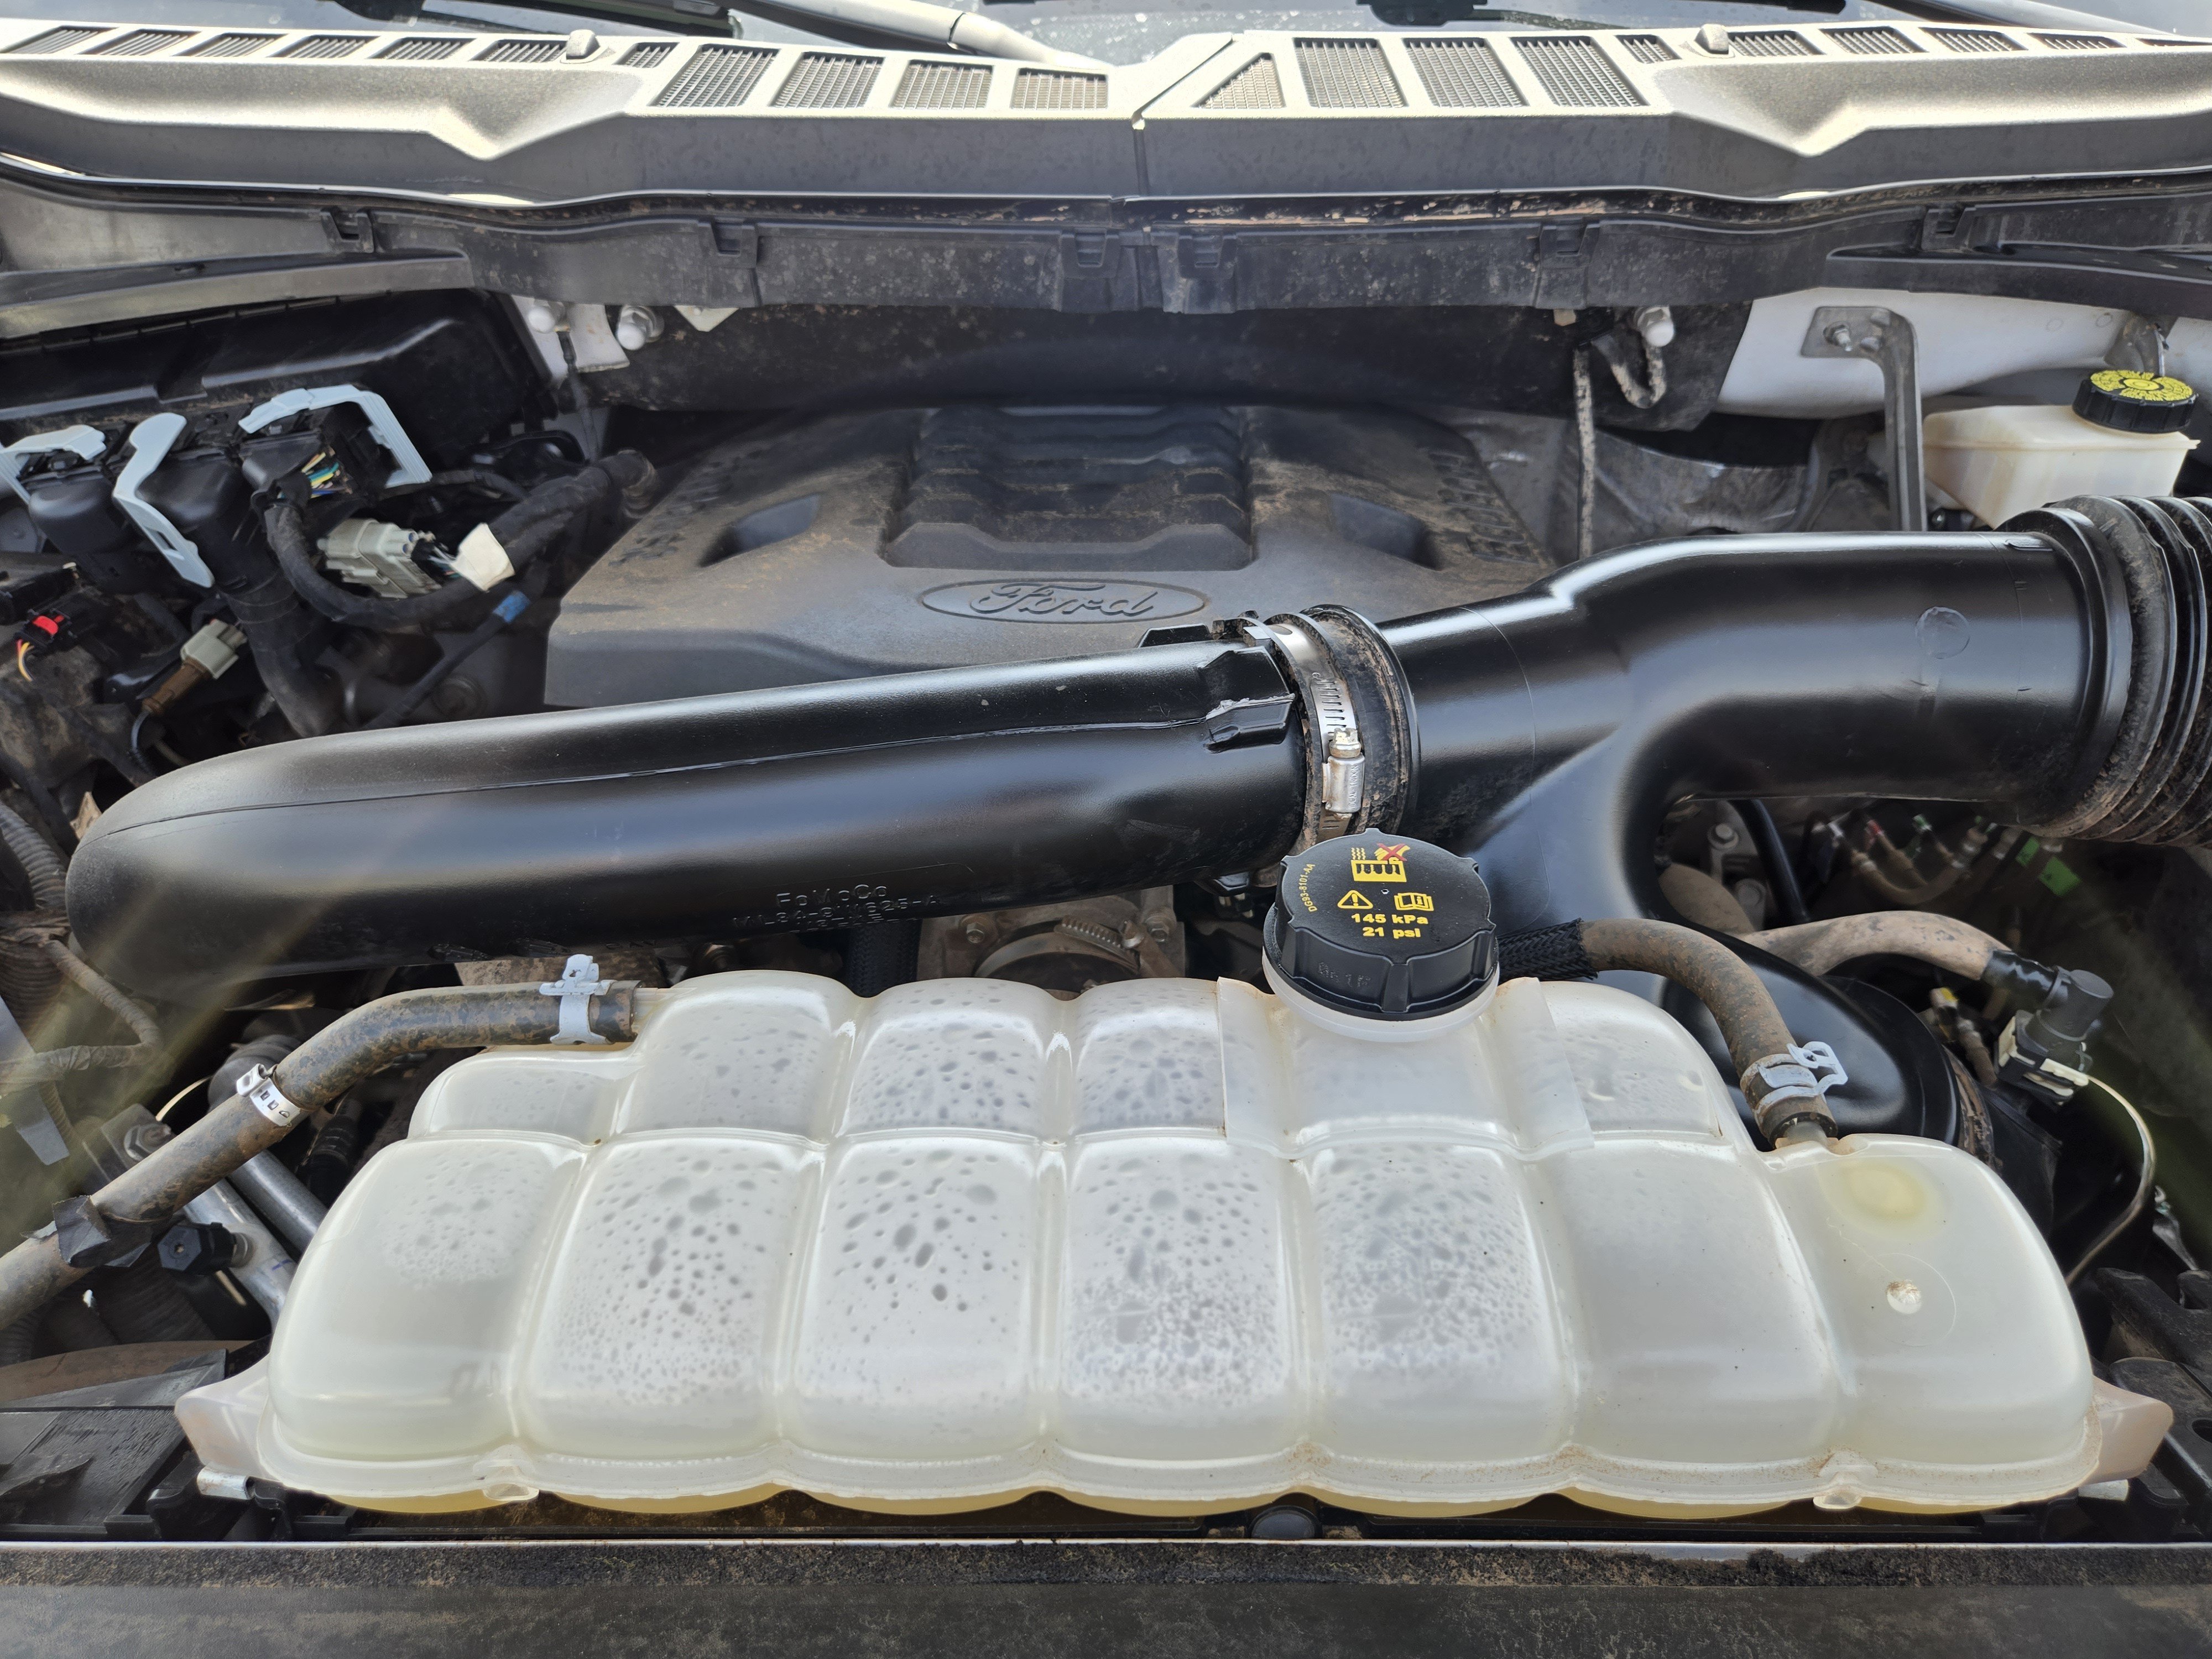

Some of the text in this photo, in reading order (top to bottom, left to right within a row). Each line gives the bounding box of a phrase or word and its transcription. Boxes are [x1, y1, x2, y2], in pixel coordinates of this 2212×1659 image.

[971, 582, 1158, 617] Ford
[1298, 864, 1317, 912] DG93-8101-AA
[1352, 914, 1428, 925] 145 kPa
[1363, 927, 1421, 939] 21 psi
